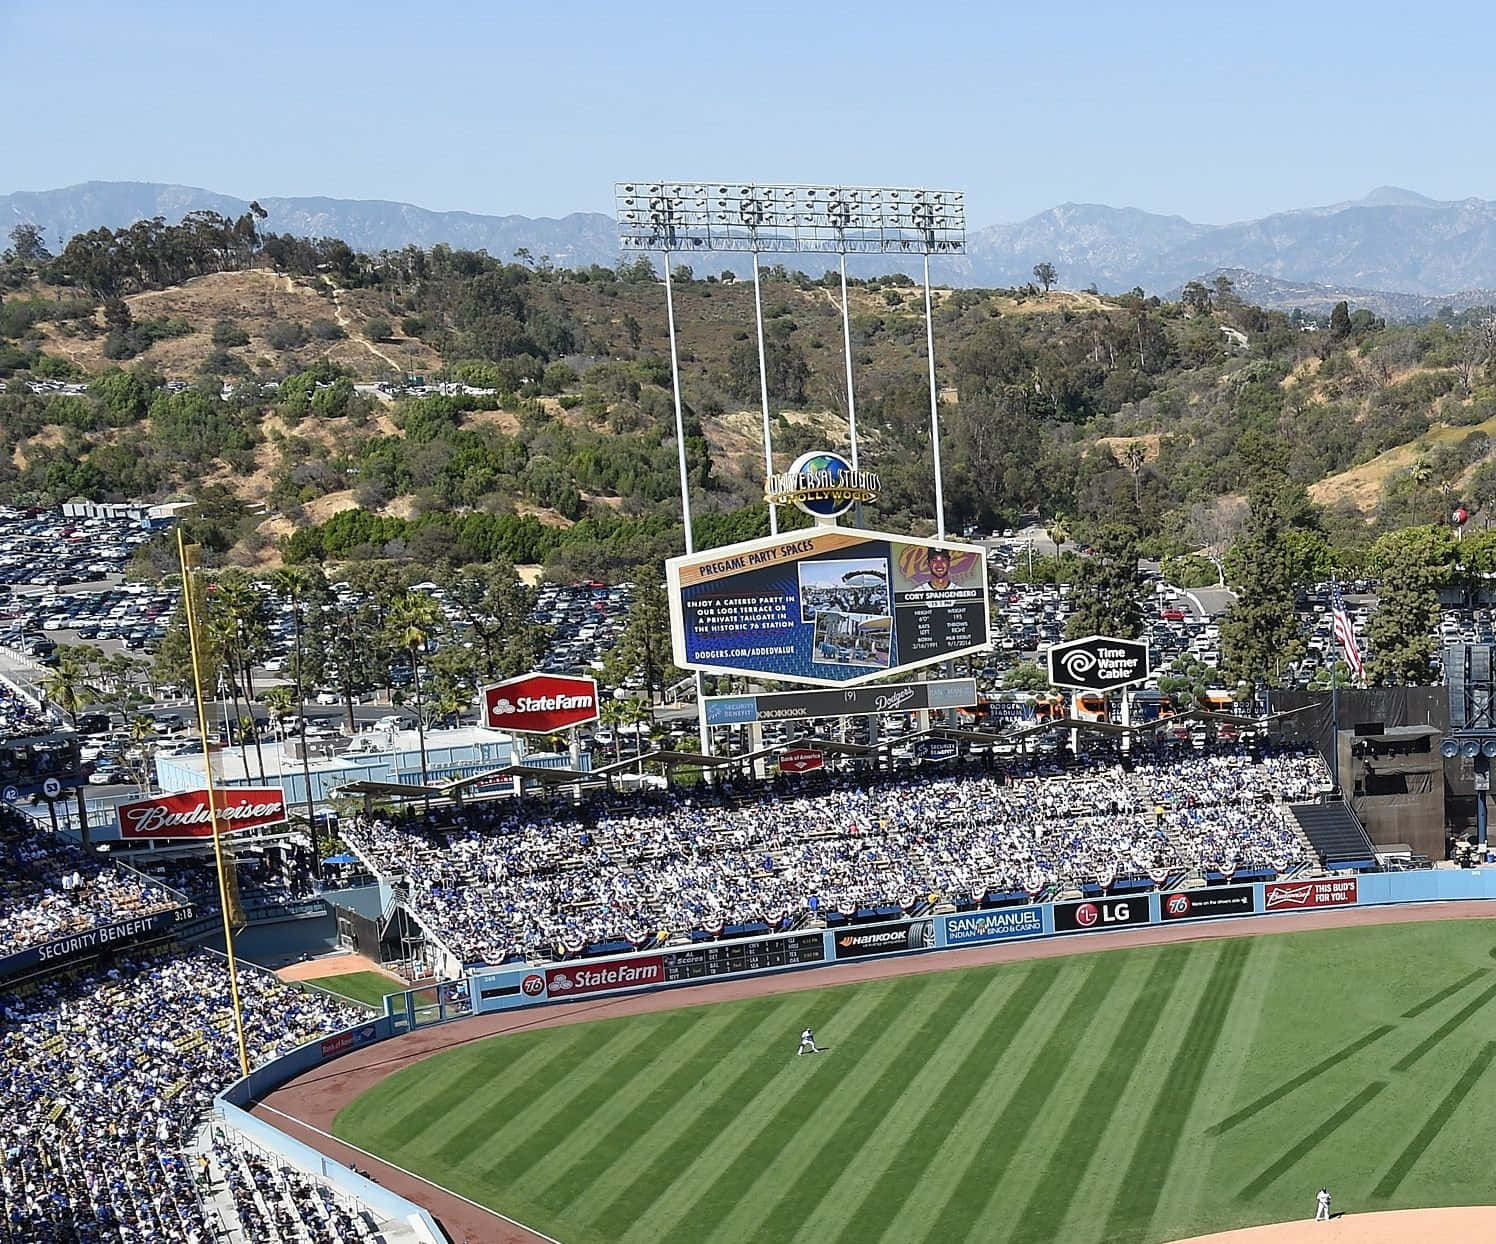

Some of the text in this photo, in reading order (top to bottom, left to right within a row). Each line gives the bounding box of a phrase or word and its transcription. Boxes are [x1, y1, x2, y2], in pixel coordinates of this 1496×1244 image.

[767, 468, 881, 496] UNIVERSAL STUDIOS
[700, 540, 814, 577] PREGAME PARTY SPACES
[687, 600, 713, 608] ENJOY
[724, 598, 757, 606] CATERED
[706, 615, 738, 623] PRIVATE
[740, 614, 775, 622] TAILGATE
[694, 621, 794, 634] THE HISTORIC 76 STATION
[695, 646, 795, 660] DODGERS.COM/ADDEDVALUE
[1097, 648, 1126, 658] Time
[1097, 658, 1138, 669] Warner
[1098, 669, 1131, 679] Cable
[874, 686, 915, 711] Dodgers
[46, 783, 58, 792] 53
[6, 790, 16, 800] 42
[1315, 882, 1355, 893] THIS BUD'S
[1315, 892, 1348, 903] FOR YOU.
[1169, 896, 1187, 913] 76
[175, 908, 193, 921] 3:18
[1103, 903, 1130, 922] LG
[948, 911, 1040, 933] SAN MANUEL
[950, 931, 976, 939] INDIAN
[987, 926, 1009, 935] BINGO
[1015, 922, 1041, 932] CASINO
[39, 918, 152, 961] SECURITY BENEFIT
[525, 978, 543, 993] 76
